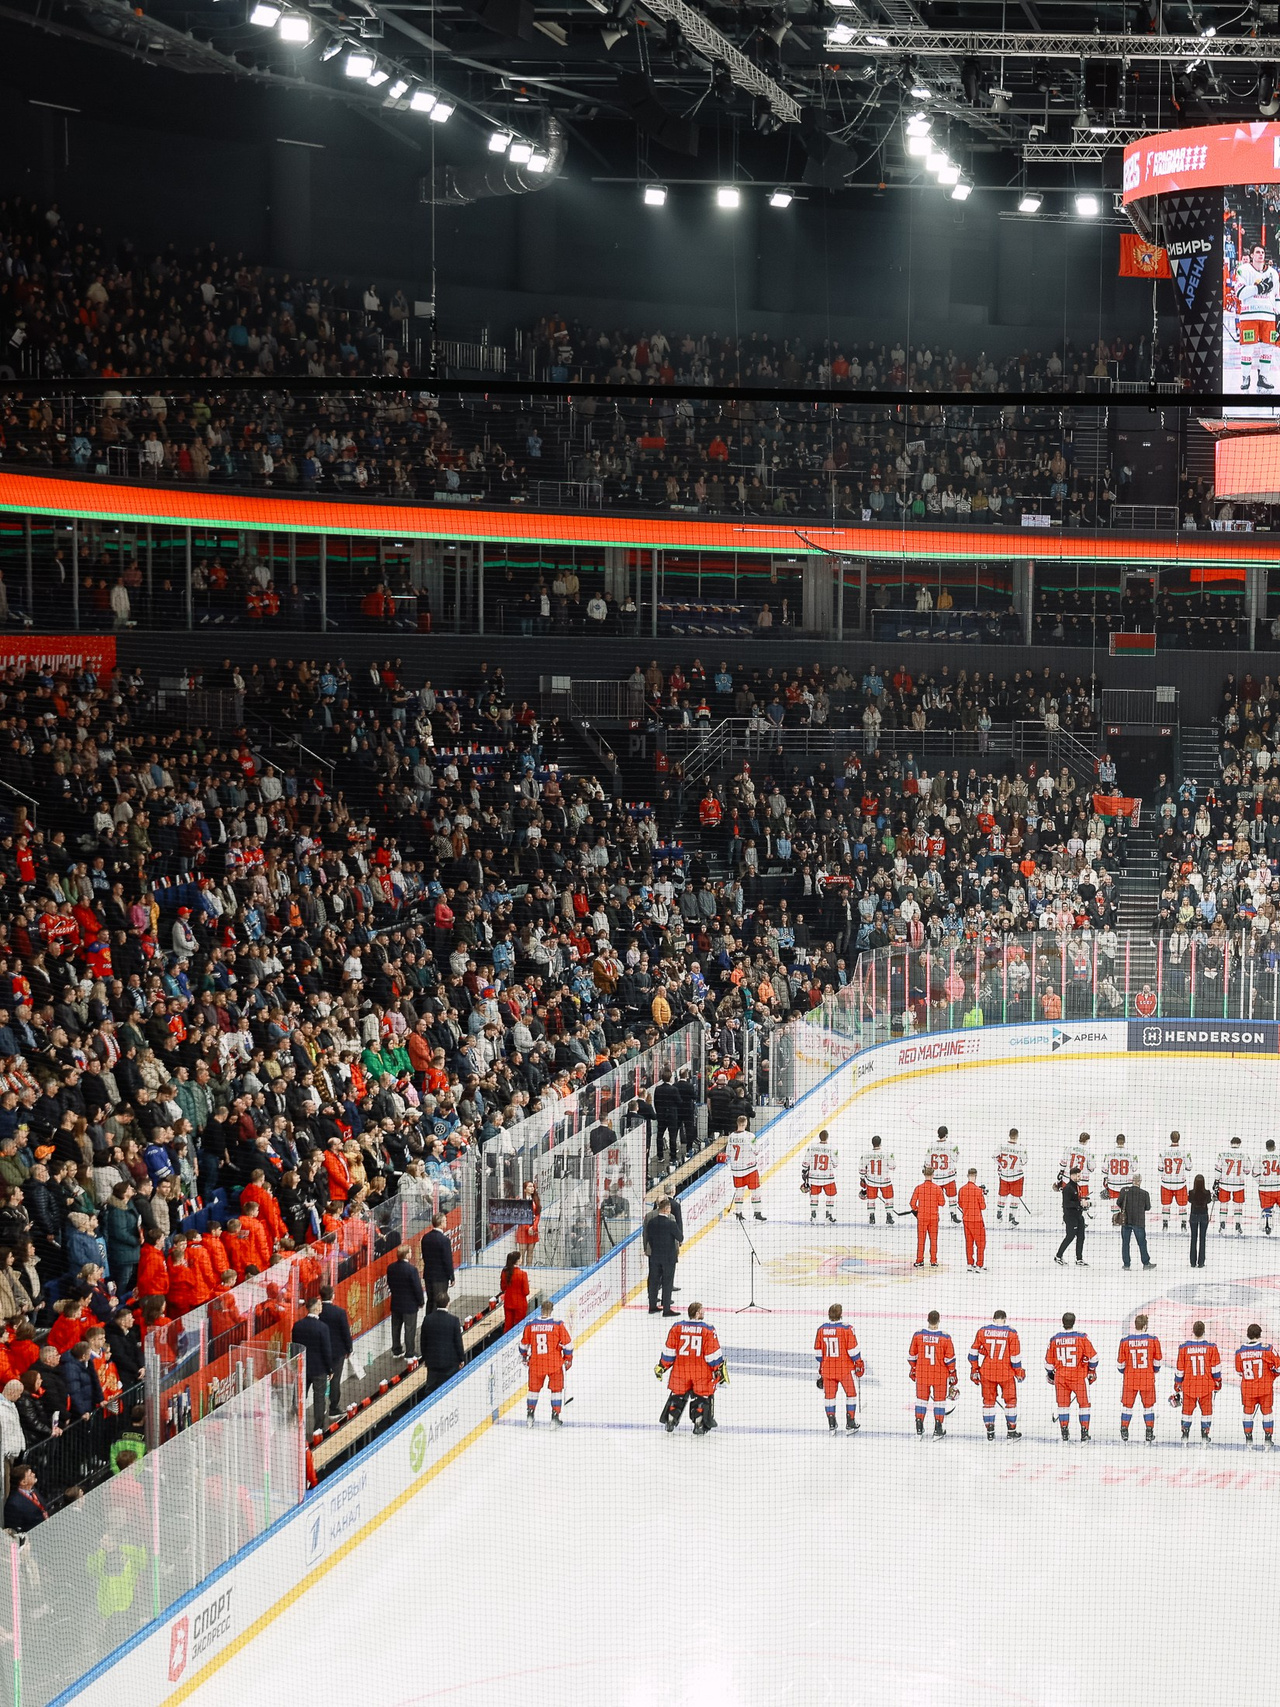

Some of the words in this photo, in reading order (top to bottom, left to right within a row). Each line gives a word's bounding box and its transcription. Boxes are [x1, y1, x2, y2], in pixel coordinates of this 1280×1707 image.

[1166, 239, 1212, 256] СИБИРЬ
[1185, 255, 1208, 310] АРЕНА
[1009, 1035, 1050, 1046] СИБИРЬ
[1073, 1032, 1108, 1043] АРЕНА
[1164, 1030, 1265, 1044] HENDERSON
[898, 1048, 916, 1066] RED
[916, 1039, 965, 1063] MACHINE
[732, 1145, 741, 1161] 7
[813, 1153, 830, 1171] 19
[931, 1153, 949, 1170] 63
[869, 1160, 882, 1176] 11
[1109, 1158, 1130, 1176] 88
[1164, 1157, 1184, 1175] 87
[1225, 1158, 1243, 1177] 71
[536, 1333, 548, 1355] 8
[679, 1334, 702, 1357] 29
[823, 1337, 840, 1358] 10
[985, 1338, 1007, 1360] 77
[924, 1345, 935, 1366] 4
[1056, 1346, 1077, 1367] 45
[1129, 1348, 1148, 1369] 13
[1190, 1355, 1205, 1376] 11
[1242, 1359, 1263, 1380] 87
[426, 1406, 460, 1445] Airlines
[328, 1470, 369, 1517] ПЕРВЫЙ
[328, 1504, 361, 1541] КАНАЛ
[192, 1586, 234, 1640] СПОРТ
[191, 1614, 232, 1661] ЭКСПРЕСС
